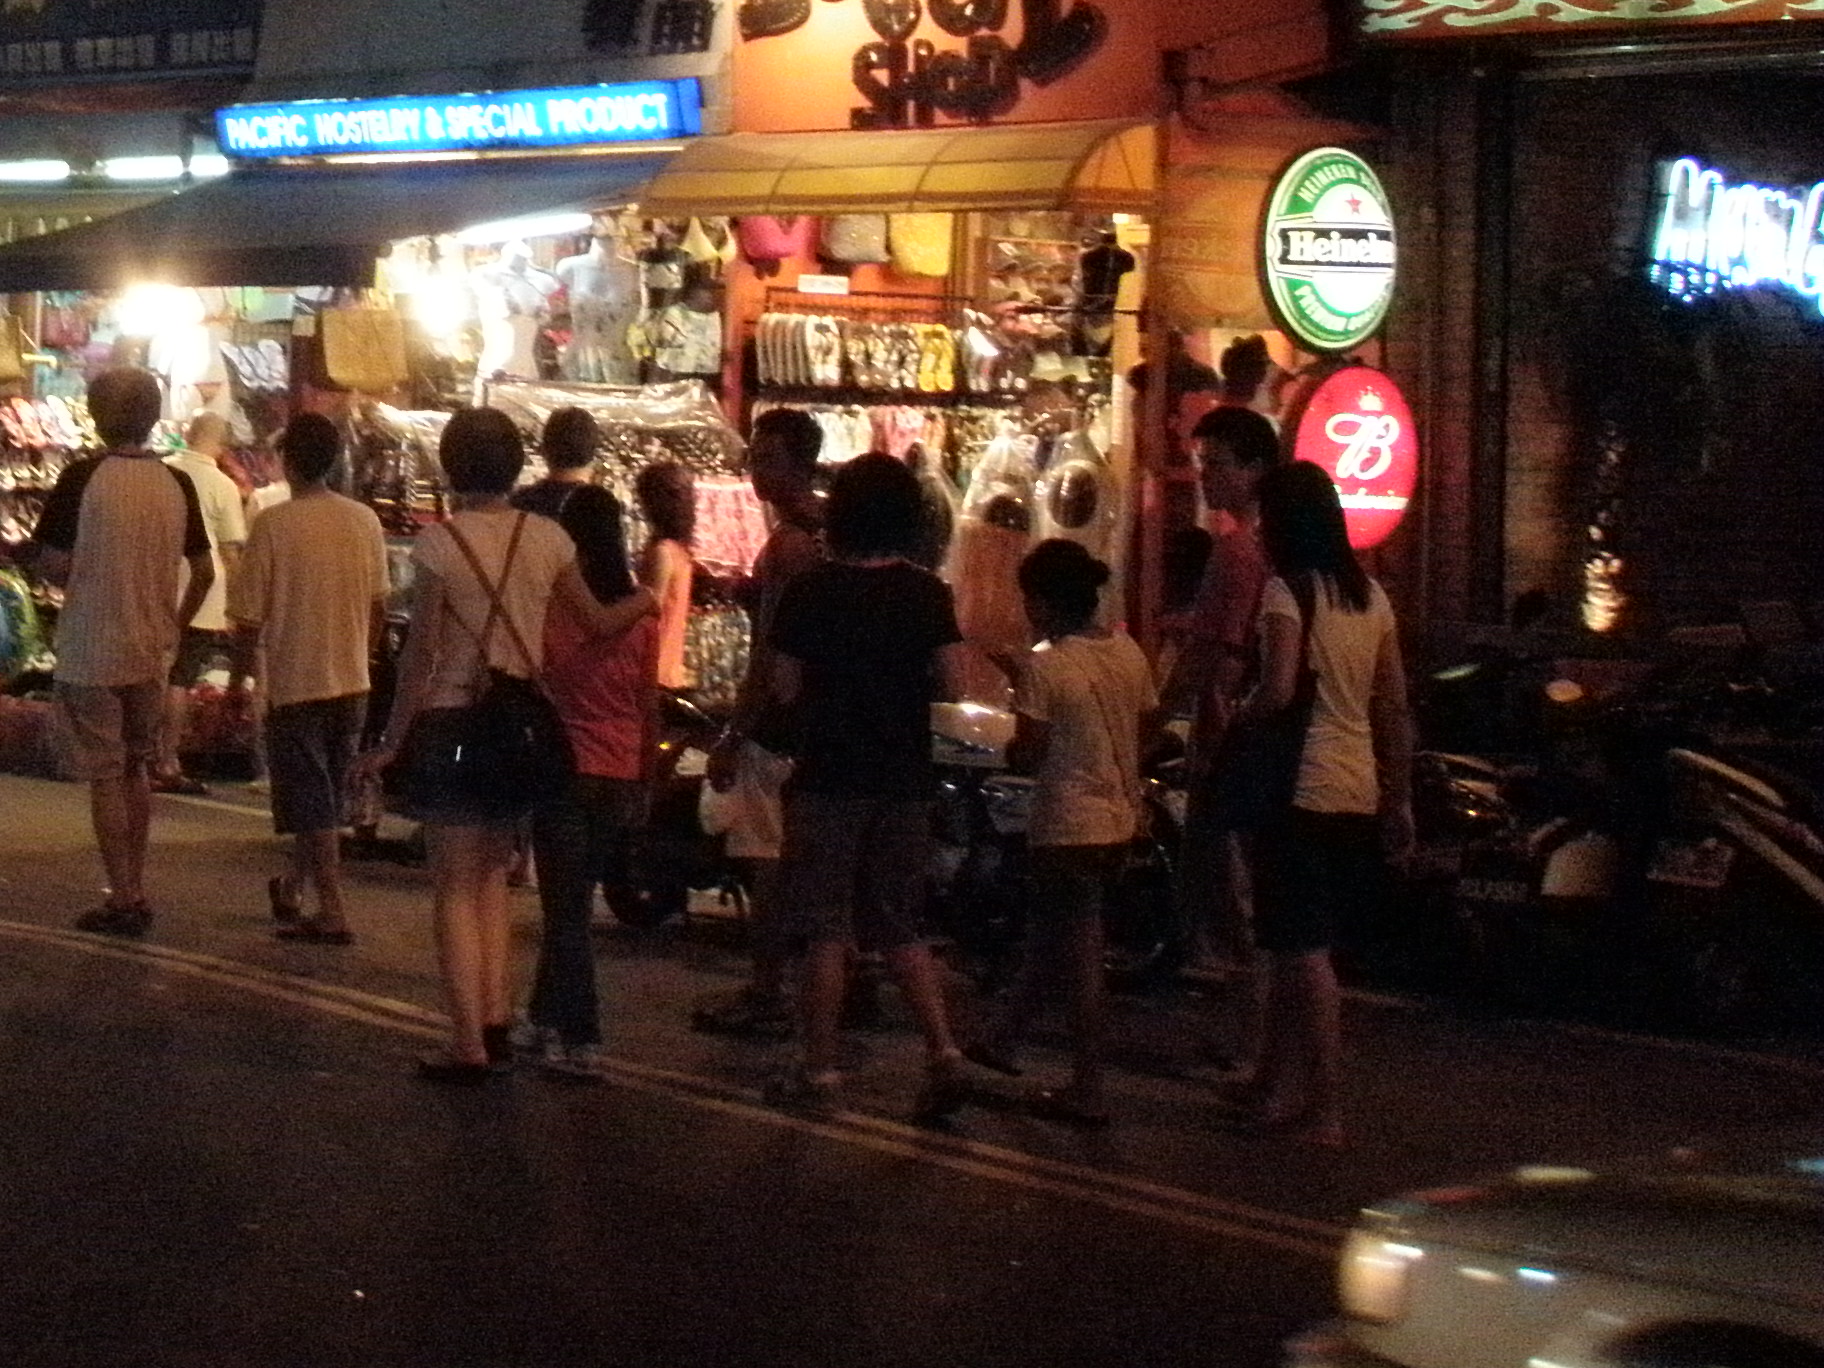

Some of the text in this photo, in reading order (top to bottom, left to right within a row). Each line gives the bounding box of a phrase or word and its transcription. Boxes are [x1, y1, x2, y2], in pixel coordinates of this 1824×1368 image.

[225, 113, 308, 150] PACIFIC
[446, 102, 541, 141] SPECIAL
[547, 92, 670, 135] PRODUCT
